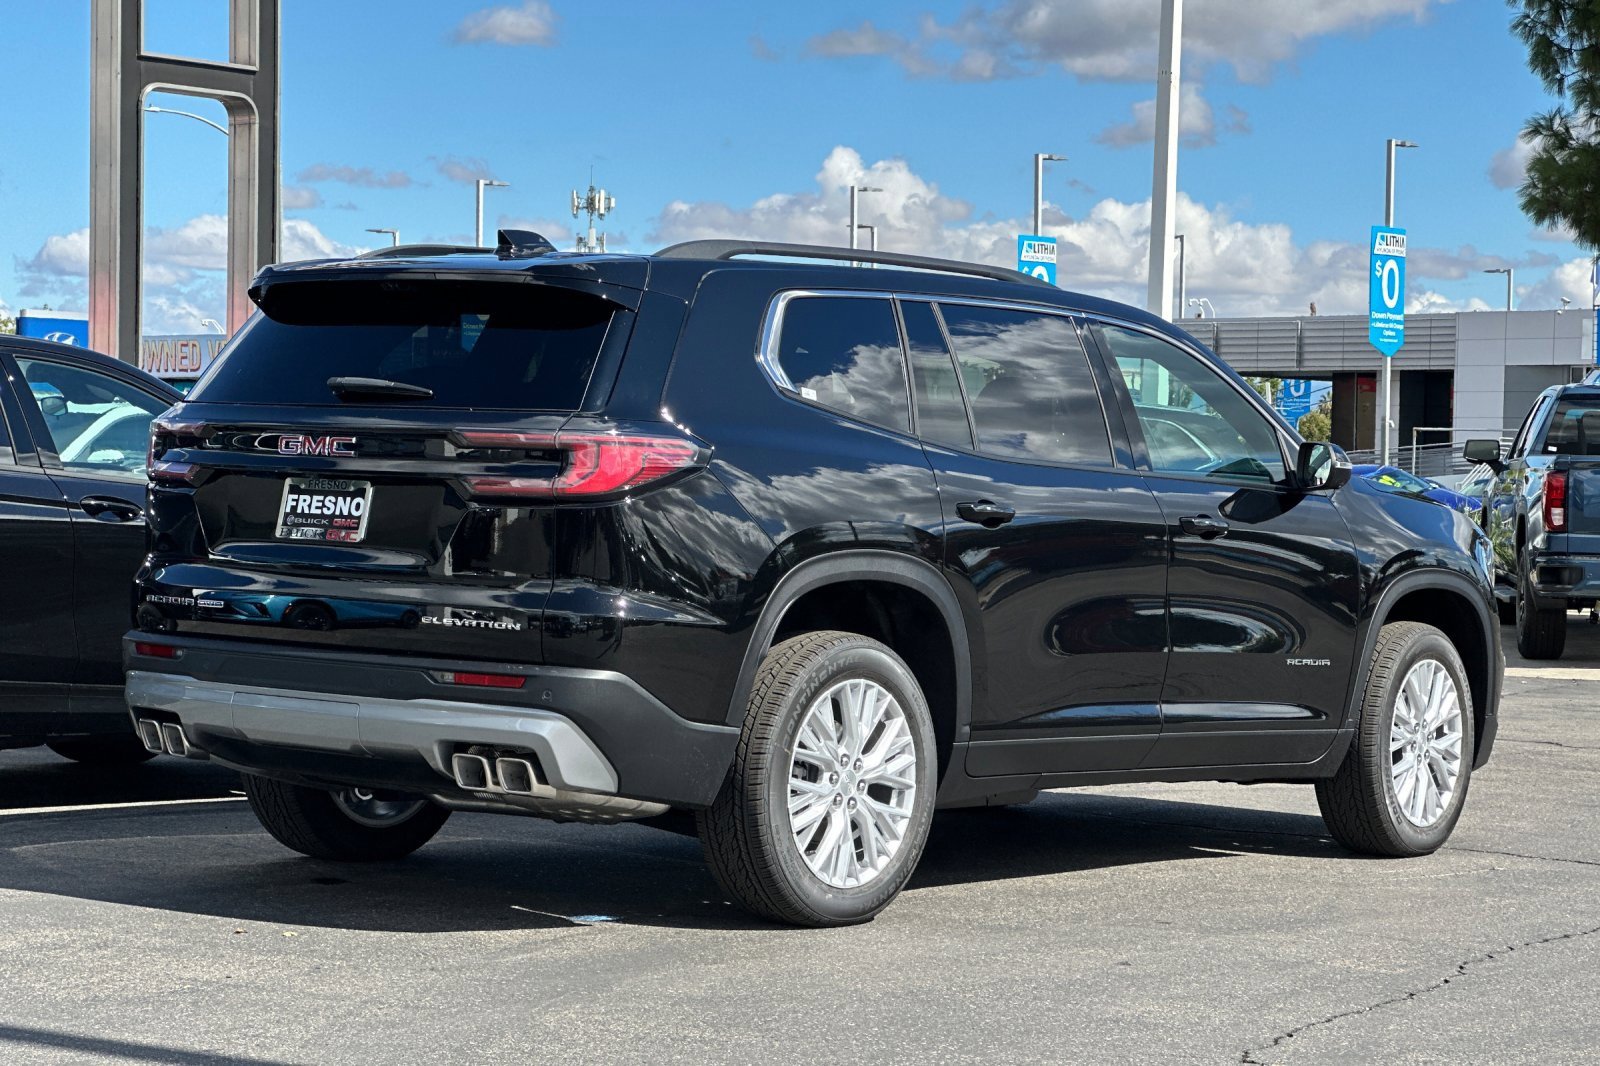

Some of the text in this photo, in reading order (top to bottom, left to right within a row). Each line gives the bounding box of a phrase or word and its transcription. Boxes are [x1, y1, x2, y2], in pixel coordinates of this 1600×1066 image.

[1033, 242, 1056, 255] LITHIA
[140, 339, 202, 373] WNED
[278, 435, 357, 457] GMC
[308, 480, 348, 490] FRESNO
[285, 494, 365, 517] FRESNO
[294, 517, 359, 527] BUICK GMC
[146, 594, 195, 606] ACADIA
[421, 616, 521, 631] ELEVATION
[1286, 658, 1331, 666] ACADIA
